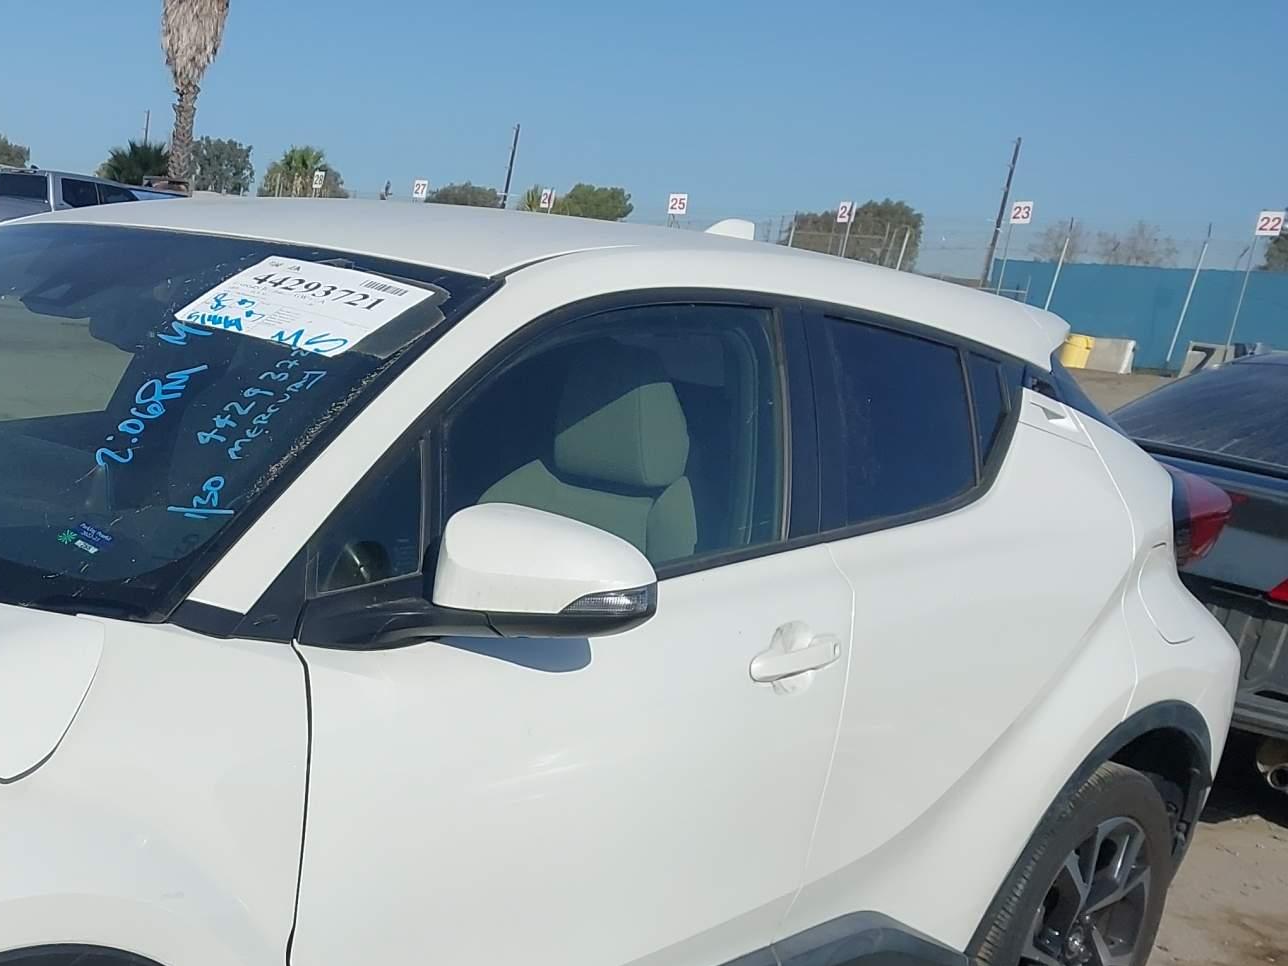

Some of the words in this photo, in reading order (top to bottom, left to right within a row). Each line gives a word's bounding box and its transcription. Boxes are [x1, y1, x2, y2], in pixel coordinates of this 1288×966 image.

[414, 183, 427, 194] 27
[669, 197, 686, 210] 25
[1012, 206, 1031, 220] 23
[1259, 216, 1282, 231] 22
[253, 273, 385, 310] 44293721
